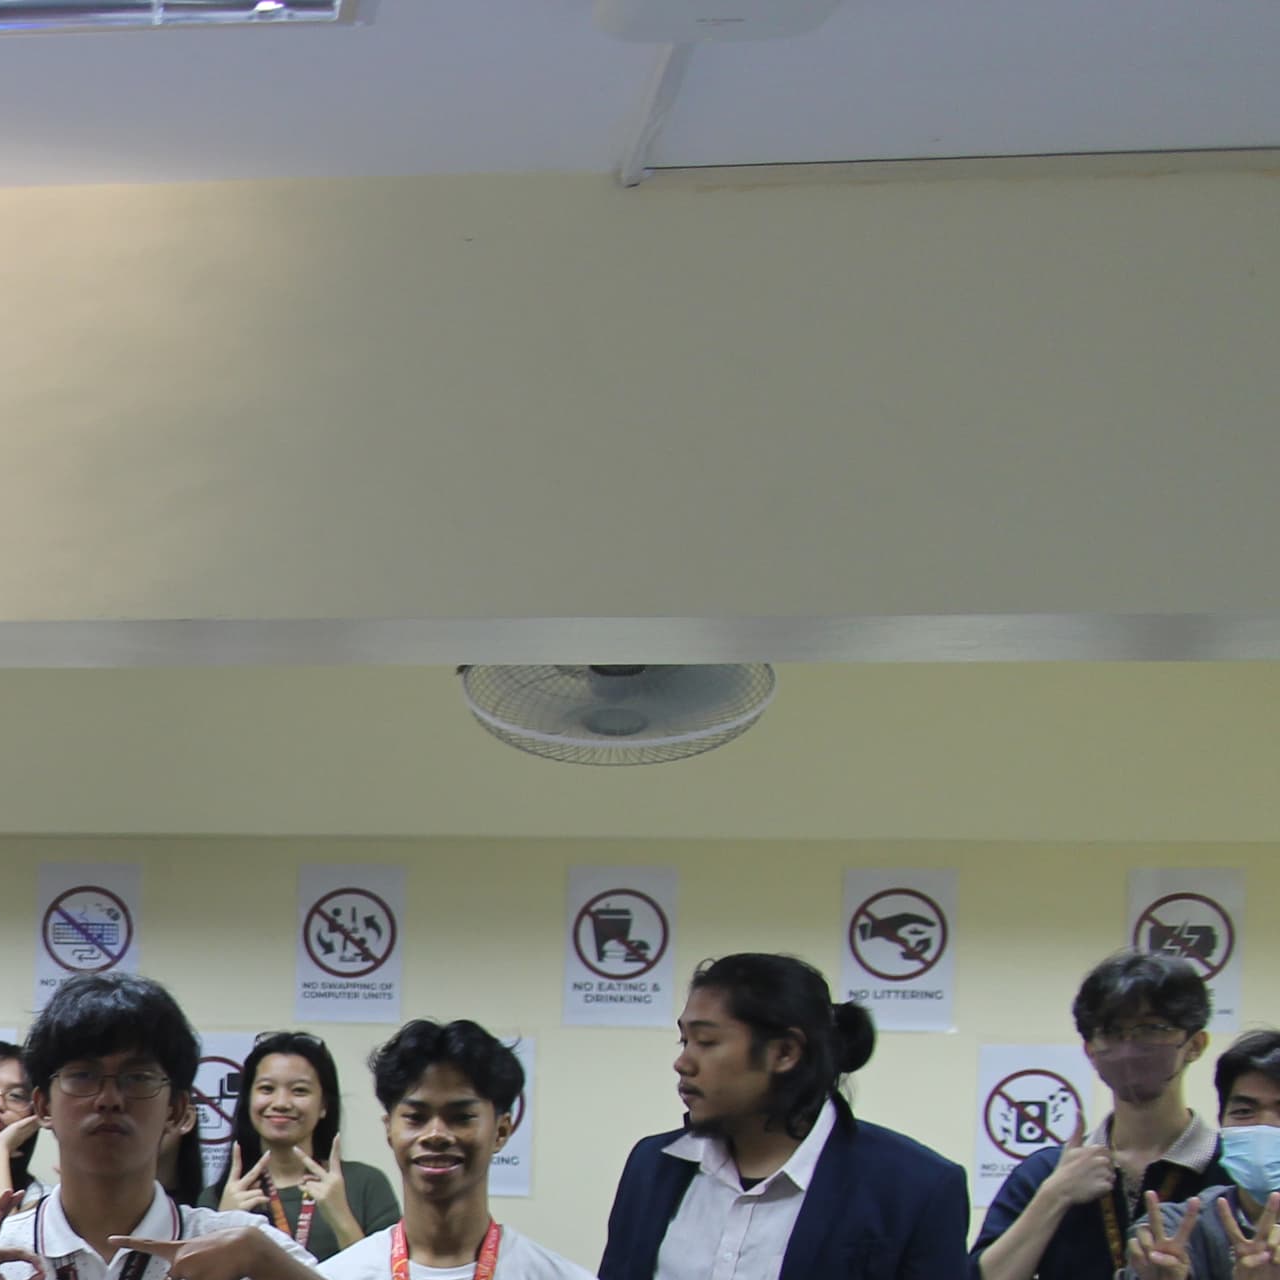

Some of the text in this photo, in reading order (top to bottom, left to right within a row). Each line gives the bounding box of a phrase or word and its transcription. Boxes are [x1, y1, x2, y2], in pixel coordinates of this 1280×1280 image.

[41, 979, 56, 987] NO
[302, 982, 319, 990] NO
[321, 982, 378, 990] SWAPPING
[572, 982, 661, 992] NO EATING &
[303, 991, 393, 1000] COMPUTER UNITS
[584, 994, 652, 1004] DRINKING
[848, 989, 944, 1000] NO LITTERING
